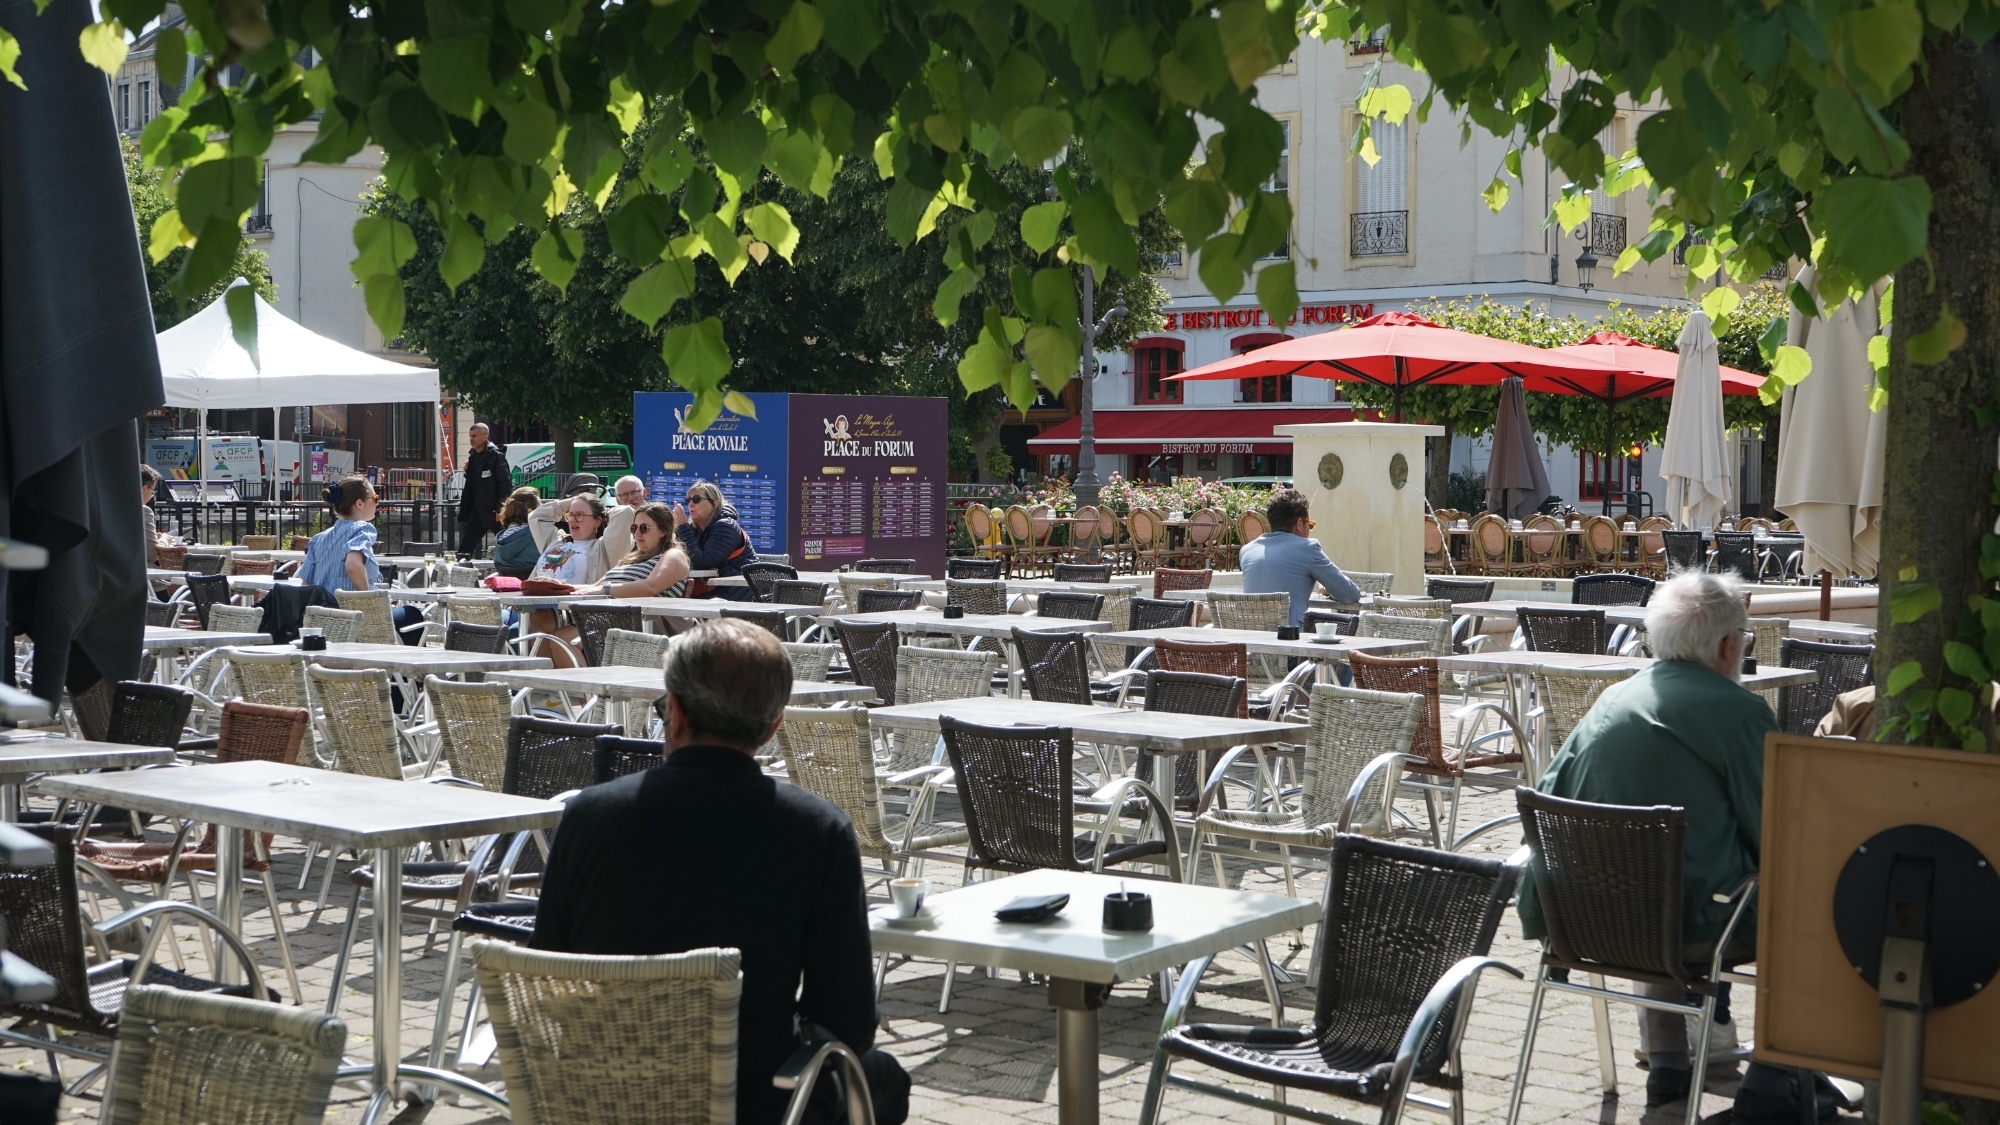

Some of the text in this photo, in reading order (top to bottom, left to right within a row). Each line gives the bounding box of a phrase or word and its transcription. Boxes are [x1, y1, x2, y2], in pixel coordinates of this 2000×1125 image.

[1165, 312, 1178, 330] E
[1182, 308, 1264, 330] BISTROT
[1302, 304, 1375, 324] FORUM
[672, 434, 748, 452] PLACE ROYALE
[823, 440, 860, 457] PLACE
[874, 440, 915, 457] FORUM
[1162, 443, 1254, 453] BISTROT DU FORUM
[804, 540, 823, 548] GRANDE
[804, 547, 823, 555] PARADE
